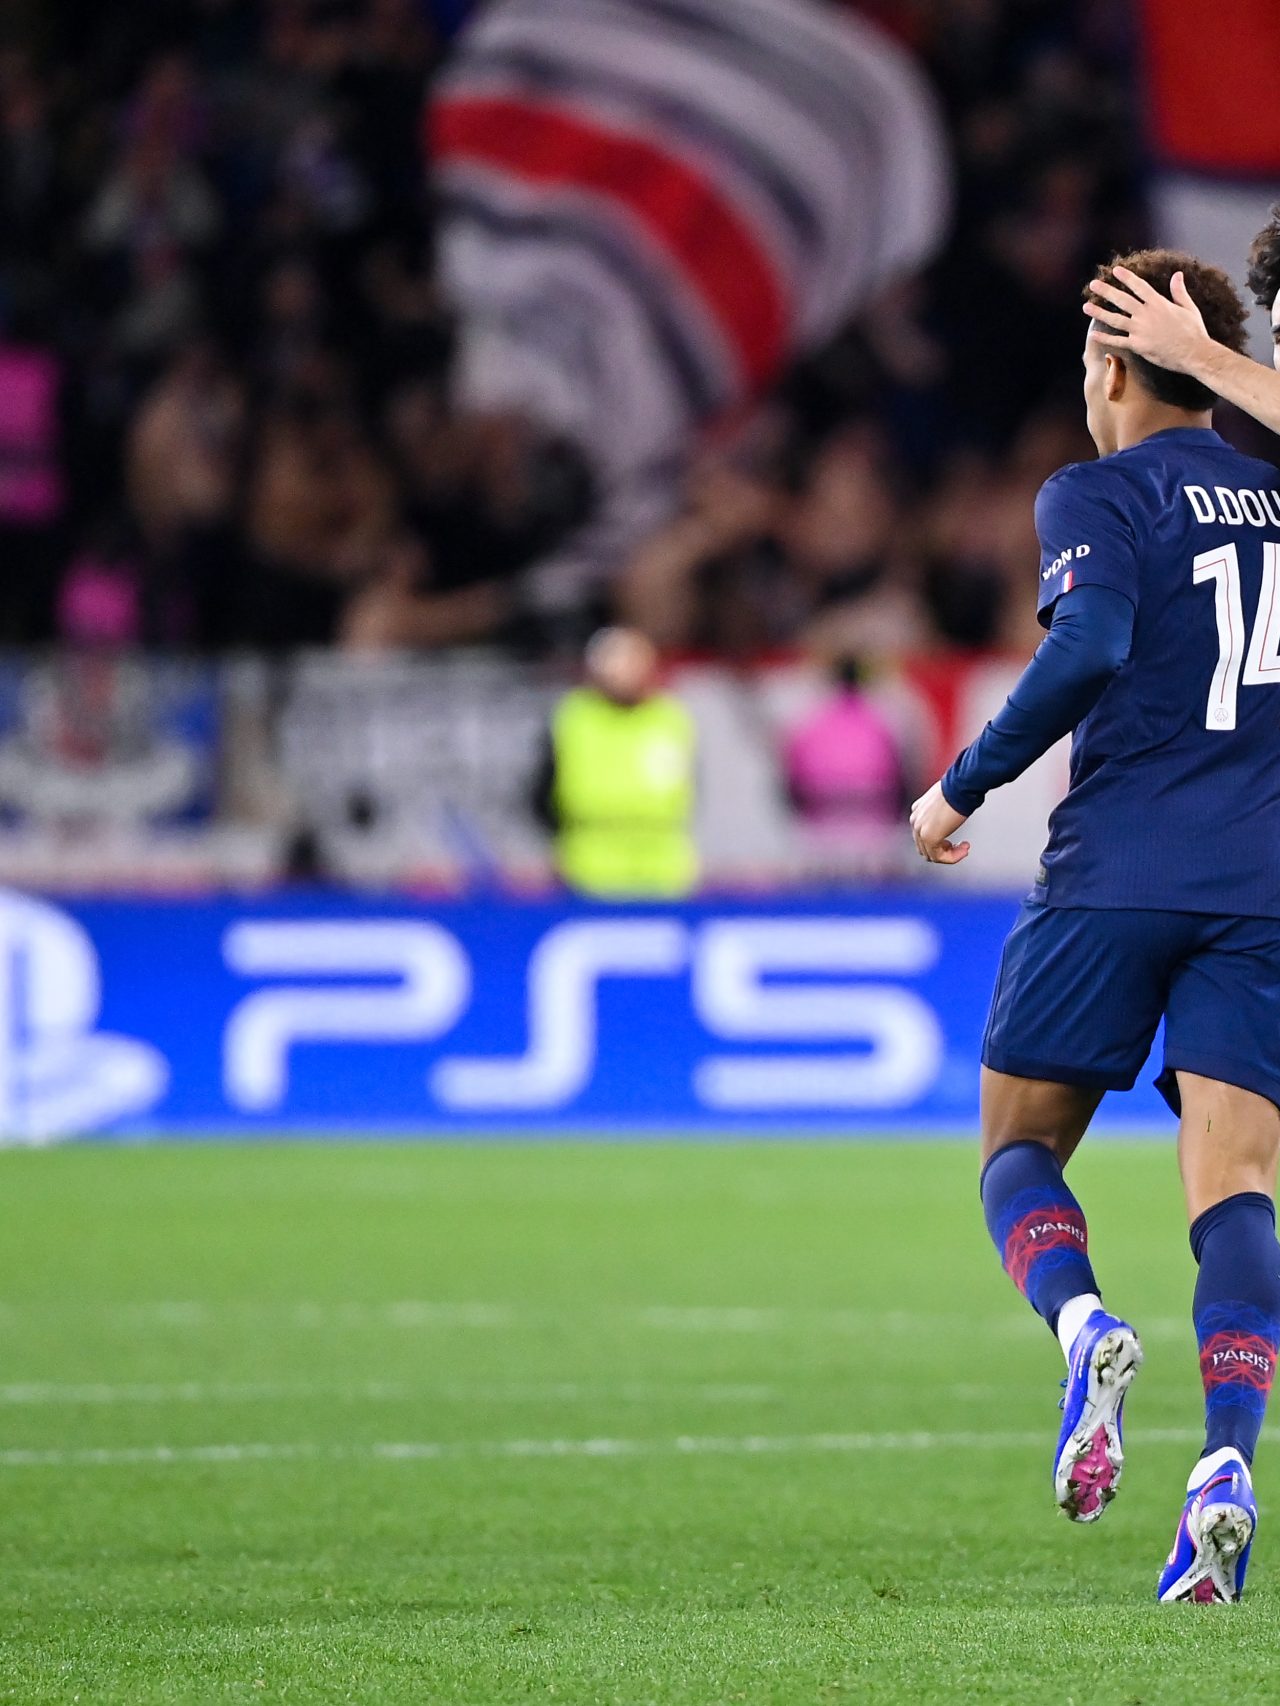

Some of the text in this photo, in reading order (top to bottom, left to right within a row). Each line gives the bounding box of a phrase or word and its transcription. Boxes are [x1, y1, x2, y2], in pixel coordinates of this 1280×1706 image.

[222, 917, 943, 1113] PS5
[1028, 1222, 1085, 1243] PARIS
[1213, 1349, 1270, 1372] PARIS
